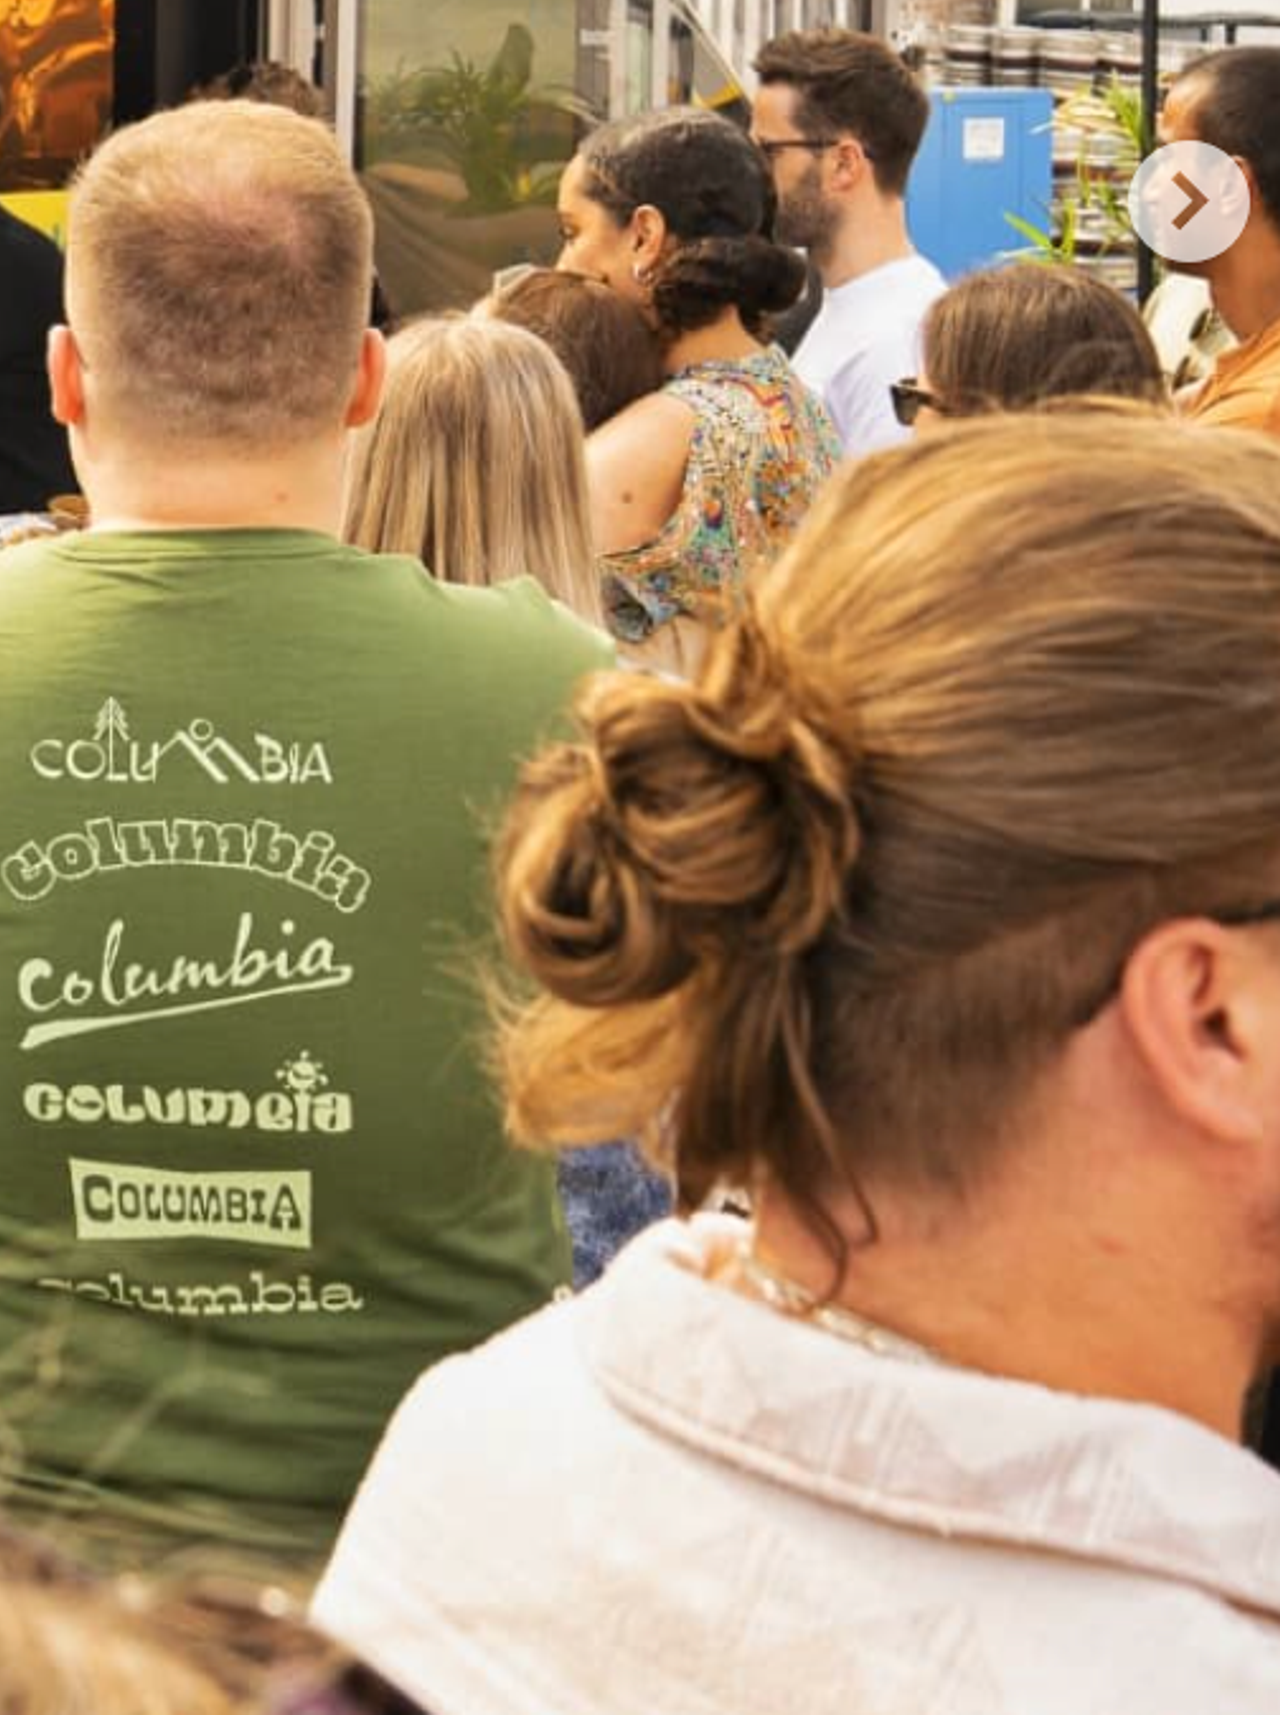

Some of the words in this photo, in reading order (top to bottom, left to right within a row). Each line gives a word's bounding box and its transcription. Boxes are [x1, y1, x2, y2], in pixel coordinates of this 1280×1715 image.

[30, 697, 333, 784] COLUMBIA
[0, 817, 372, 913] Columbia
[18, 912, 353, 1013] Columbia
[81, 1173, 302, 1231] COLUMBIA
